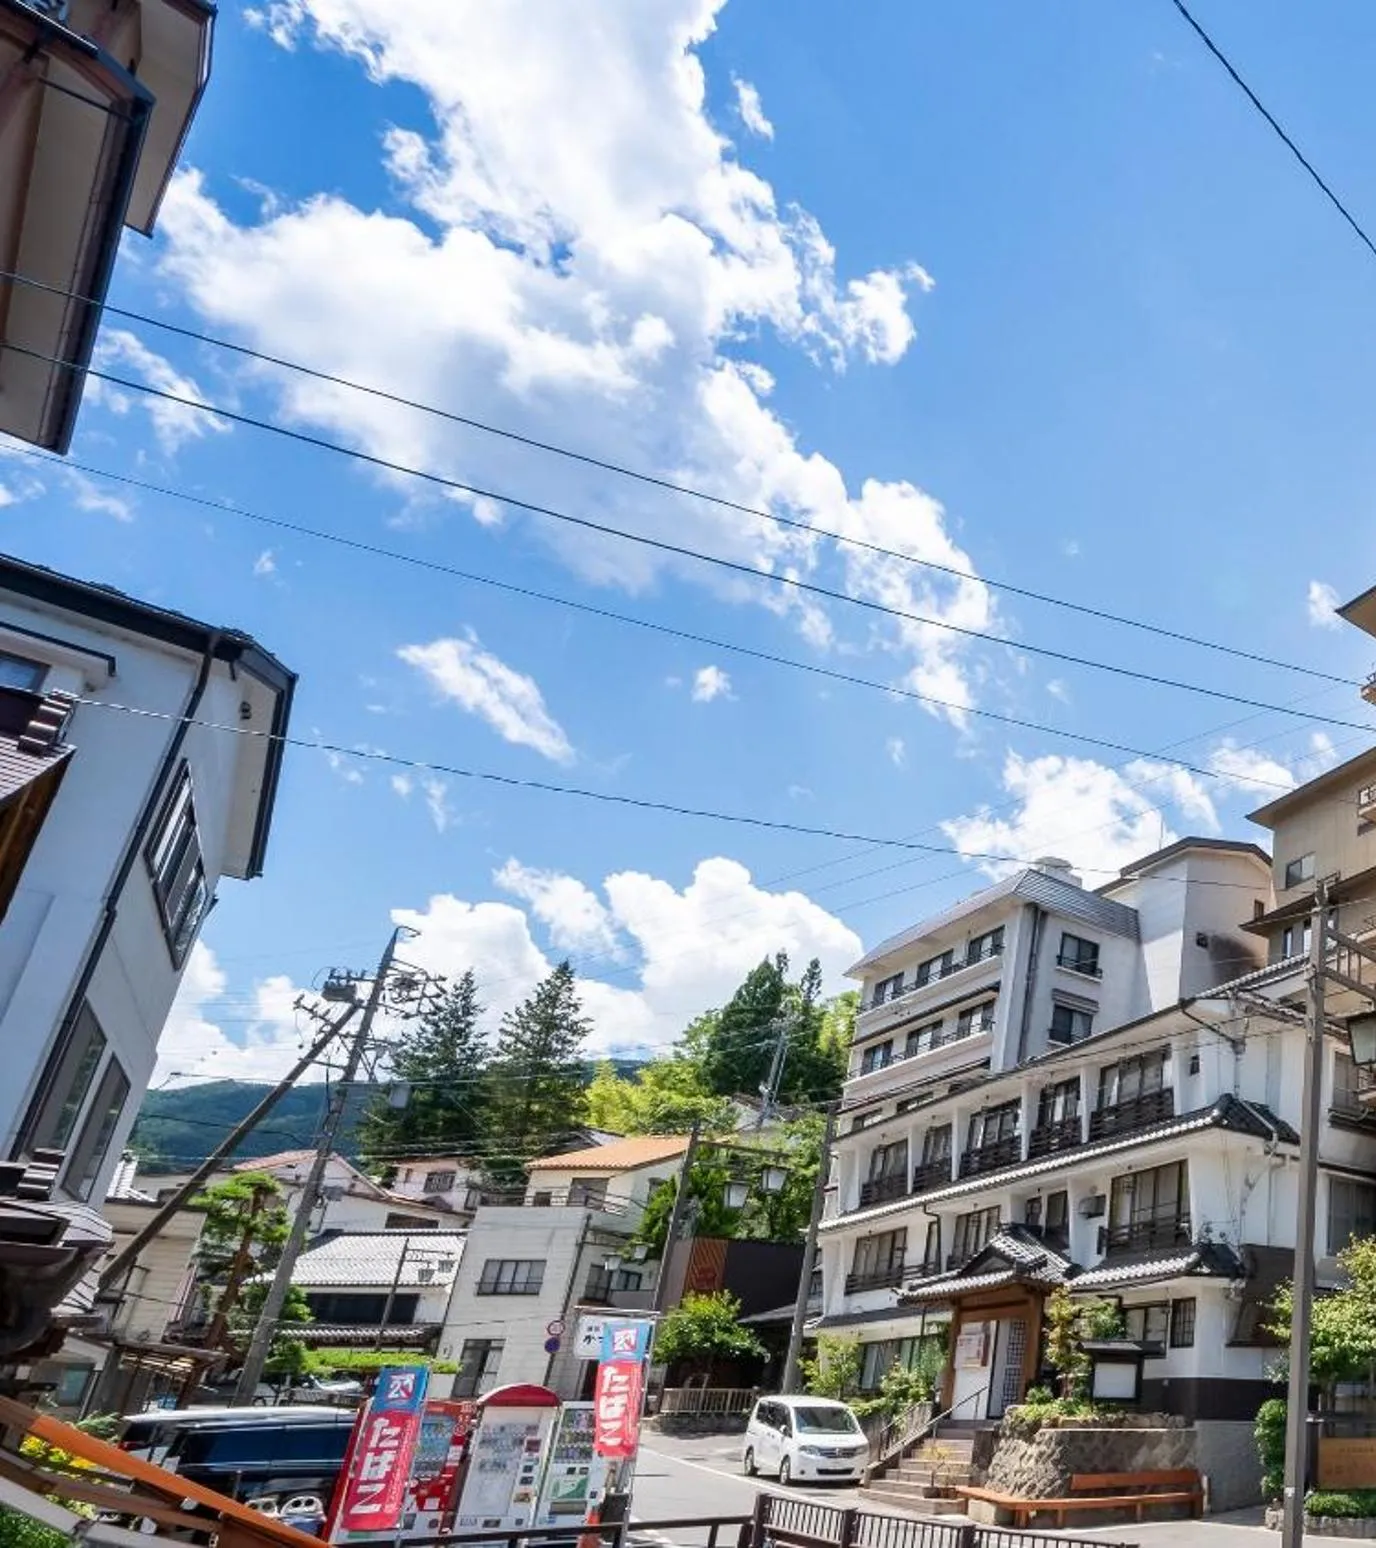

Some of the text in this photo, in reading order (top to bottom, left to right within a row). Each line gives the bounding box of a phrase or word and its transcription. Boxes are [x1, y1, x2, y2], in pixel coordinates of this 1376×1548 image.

[600, 1365, 631, 1446] たばこ
[350, 1417, 401, 1514] たばこ
